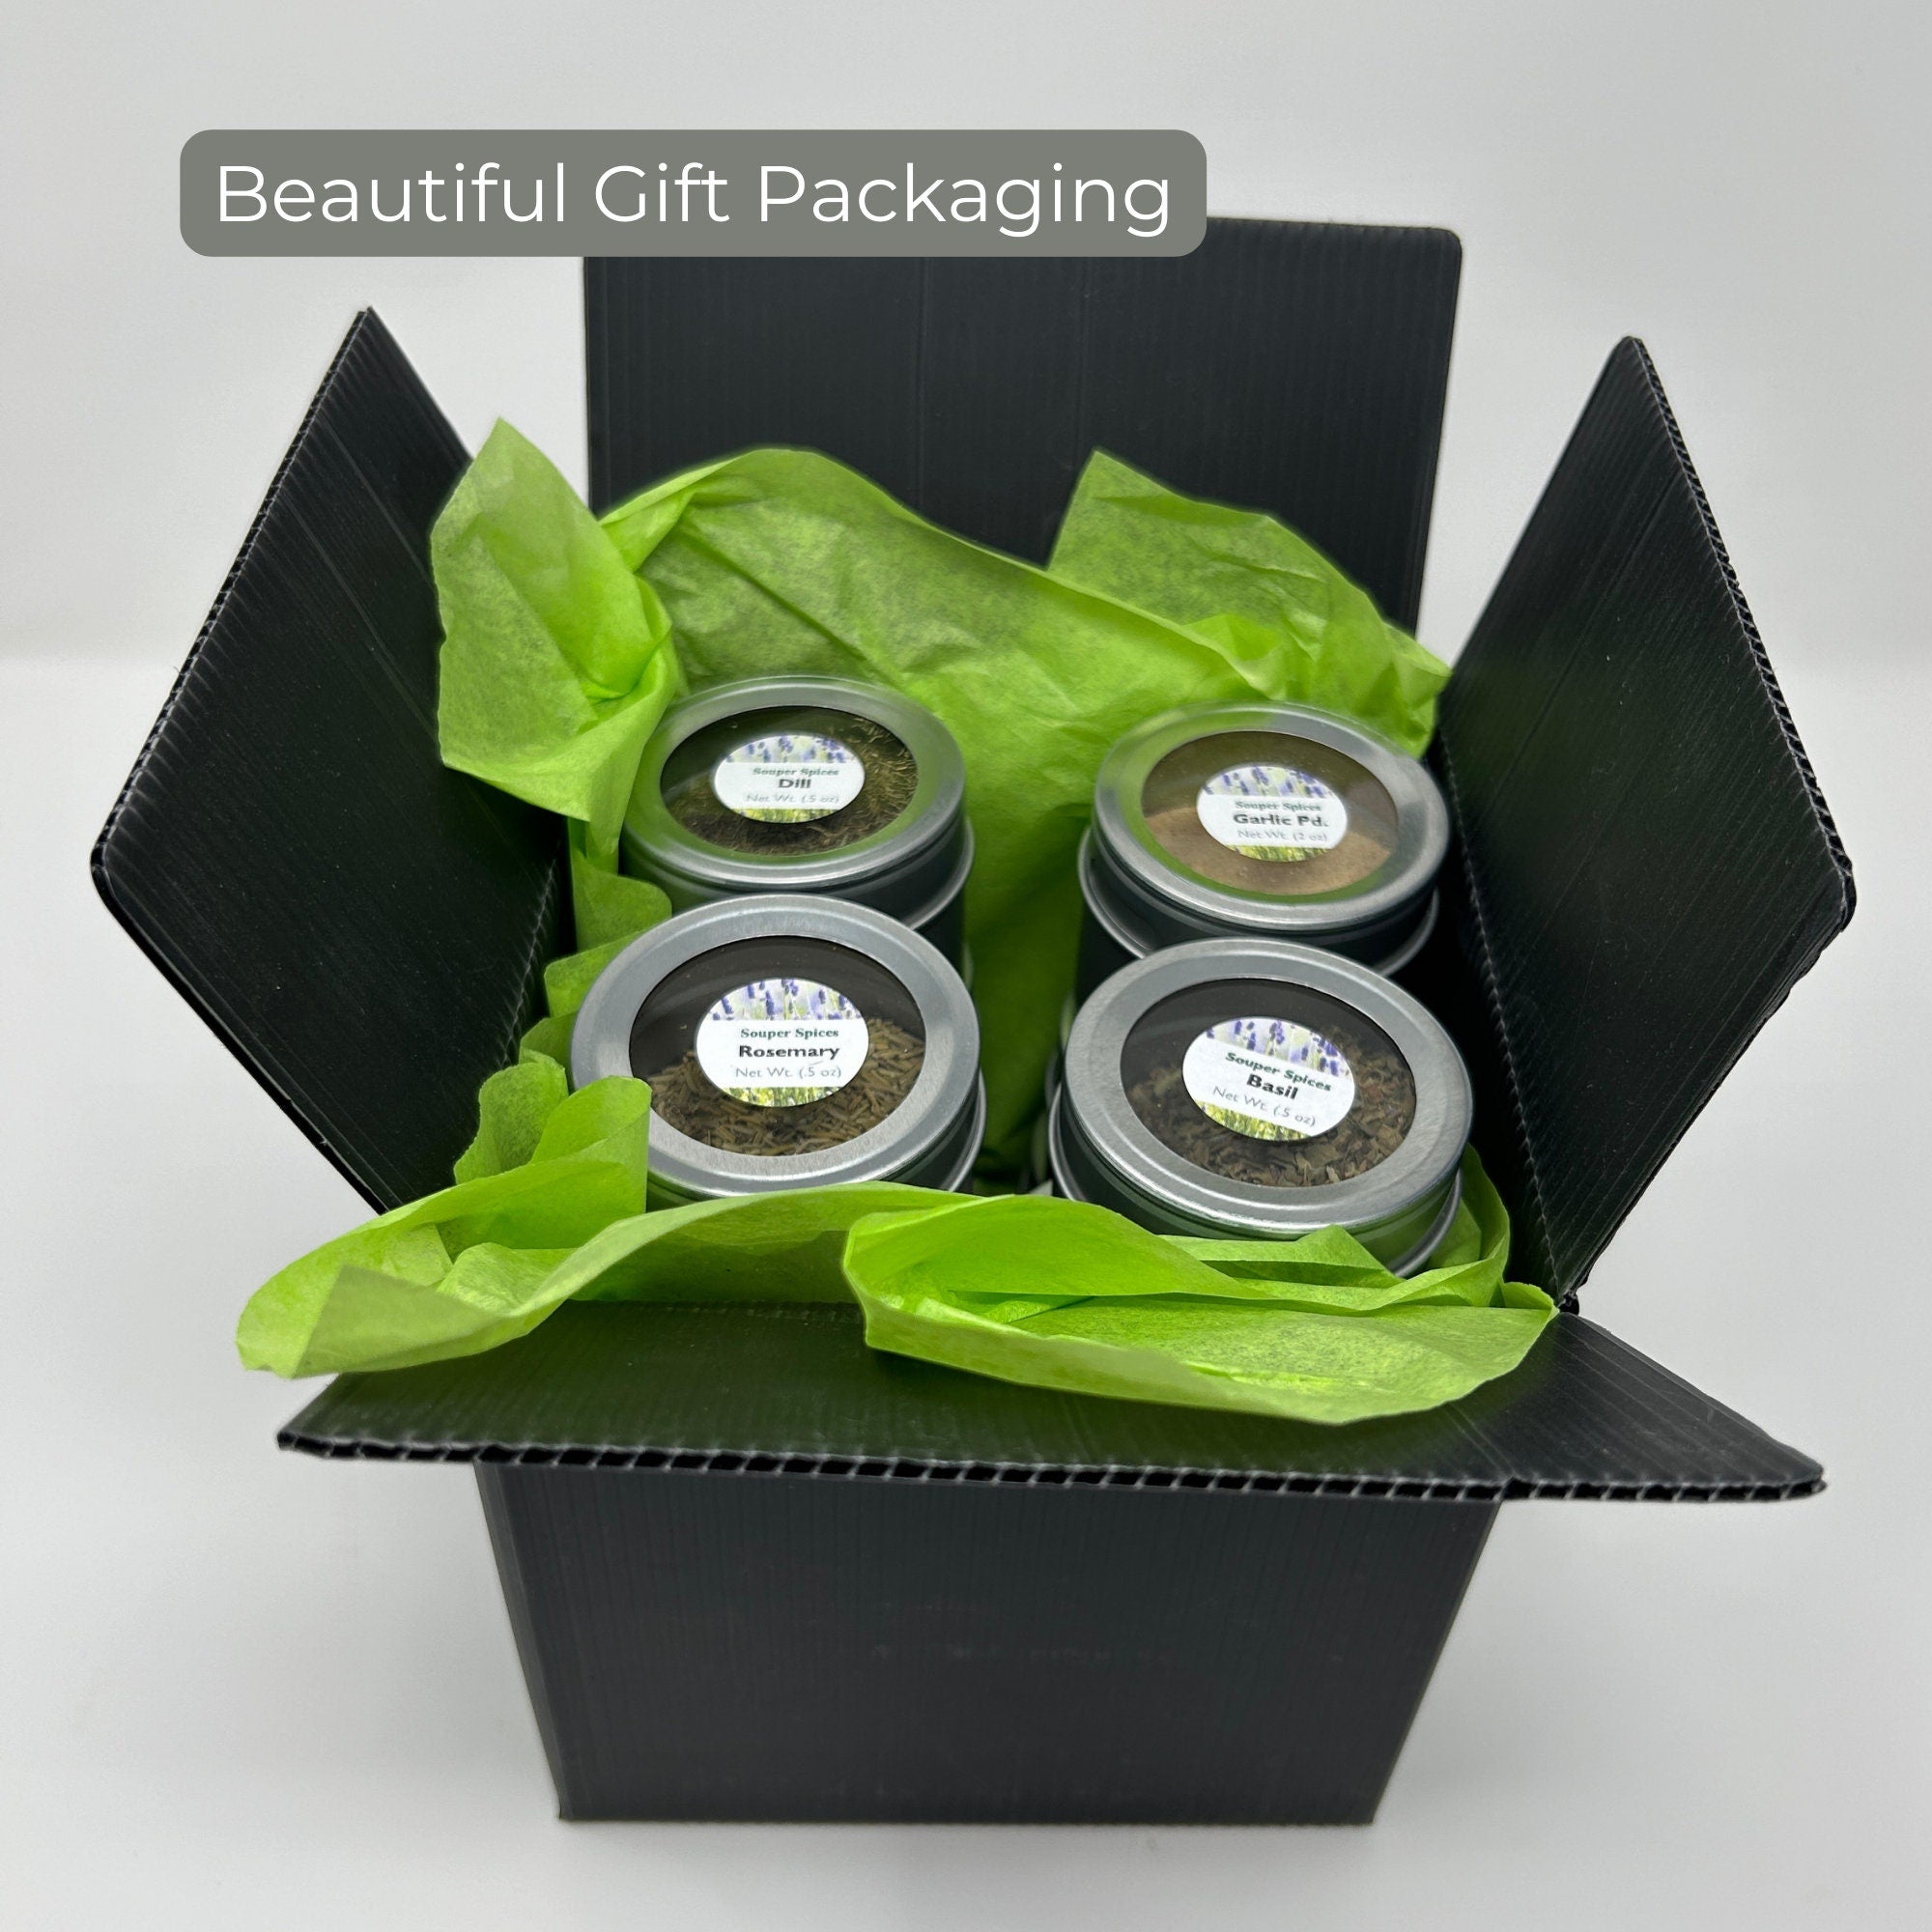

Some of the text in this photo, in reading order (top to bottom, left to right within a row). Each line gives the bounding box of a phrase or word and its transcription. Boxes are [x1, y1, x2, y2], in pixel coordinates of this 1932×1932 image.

[753, 767, 840, 777] Souper Spices
[778, 779, 811, 788] Dill
[746, 793, 769, 803] Net
[1235, 801, 1321, 812] Souper Spices
[1233, 813, 1328, 827] Garlic Pd.
[1237, 829, 1263, 838] Net
[740, 1028, 839, 1040] Souper Spices
[738, 1044, 840, 1061] Rosemary
[735, 1066, 761, 1078] Net
[799, 1066, 815, 1079] (.5
[820, 1066, 842, 1079] oz)
[1225, 1052, 1332, 1092] Souper Spices
[1246, 1073, 1299, 1100] Basil
[1212, 1085, 1238, 1102] Net
[1294, 1114, 1316, 1127] oz)
